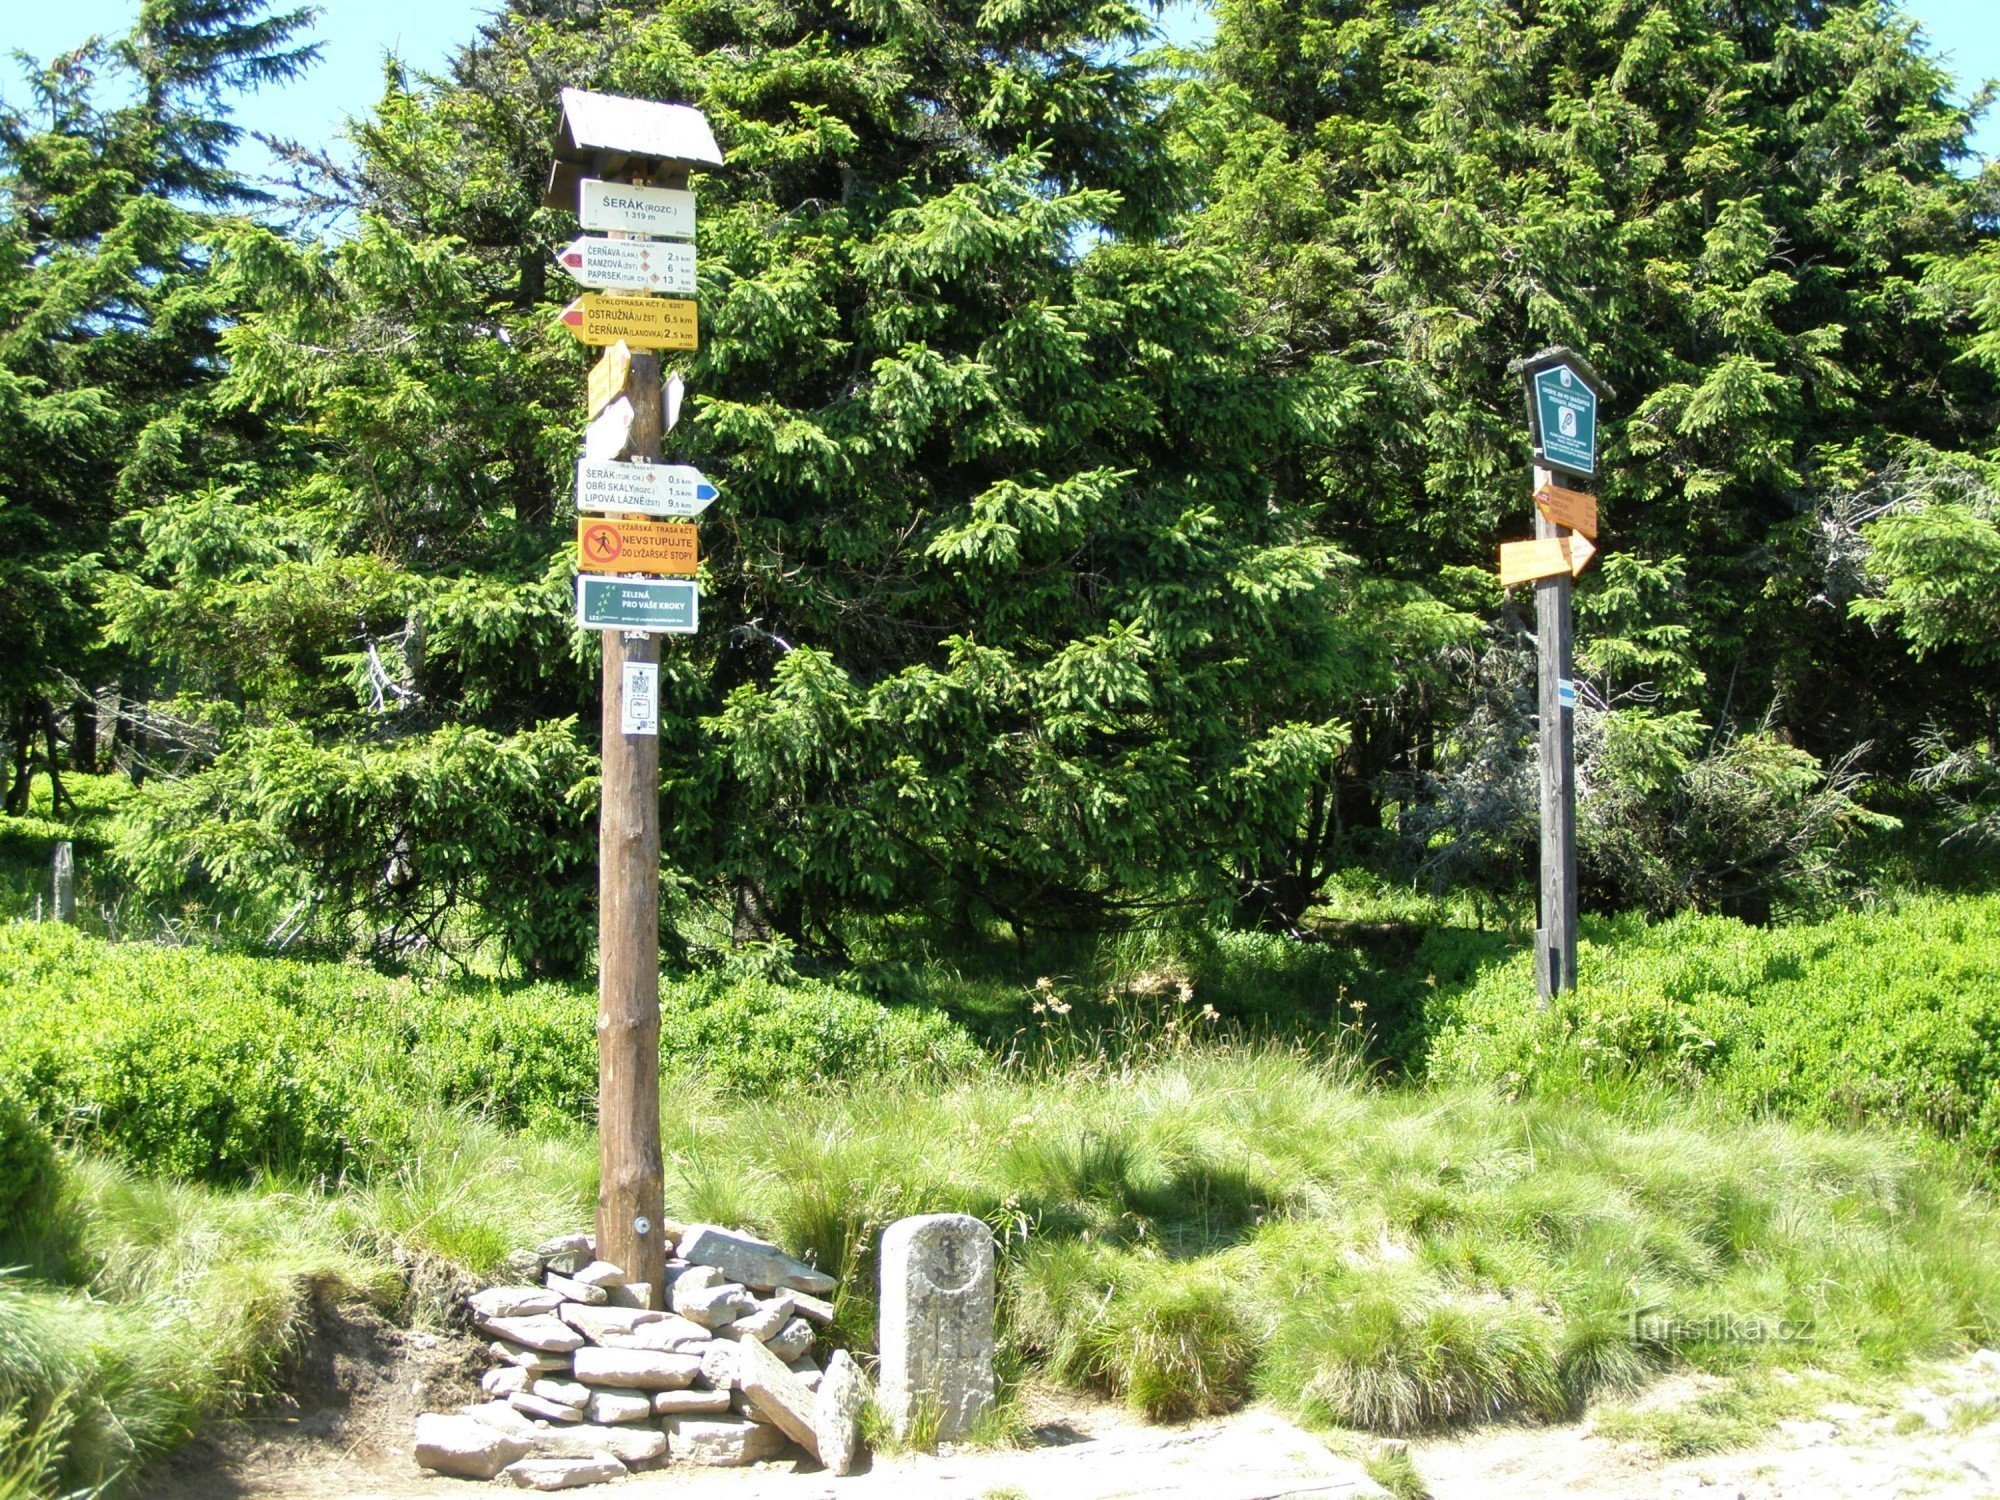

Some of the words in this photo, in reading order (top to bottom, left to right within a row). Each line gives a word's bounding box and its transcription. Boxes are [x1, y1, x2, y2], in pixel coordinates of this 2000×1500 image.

[603, 196, 643, 211] ŠERÁK
[645, 205, 677, 216] (ROZC.)
[632, 212, 646, 220] 319
[587, 245, 620, 257] ČERŇAVA
[668, 252, 680, 262] 2,5
[587, 258, 622, 269] RAMZOVÁ
[667, 264, 674, 273] 6
[587, 270, 621, 281] PAPRSEK
[663, 276, 674, 285] 13
[596, 299, 645, 307] CYKLOTRASA
[588, 309, 635, 321] OSTRUŽNÁ
[664, 314, 678, 324] 6,5
[680, 316, 692, 324] km
[588, 324, 629, 336] ČERŇAVA
[629, 330, 663, 339] (LANOVKA)
[664, 330, 678, 339] 2,5
[586, 468, 615, 479] ŠERÁK
[668, 475, 680, 484] 0,5
[586, 481, 606, 490] OBŘÍ
[608, 482, 634, 492] SKÁLY
[669, 487, 680, 496] 1,5
[585, 494, 616, 503] LIPOVÁ
[618, 495, 645, 505] LÁZNĚ
[668, 499, 680, 508] 9,5
[618, 523, 652, 533] LYŽAŘSKÁ
[622, 535, 693, 548] NEVSTUPUJTE
[622, 549, 632, 557] DO
[634, 548, 668, 559] LYŽAŘSKÉ
[671, 551, 693, 560] STOPY
[622, 590, 649, 599] ZELENÁ
[639, 601, 657, 609] VAŠE
